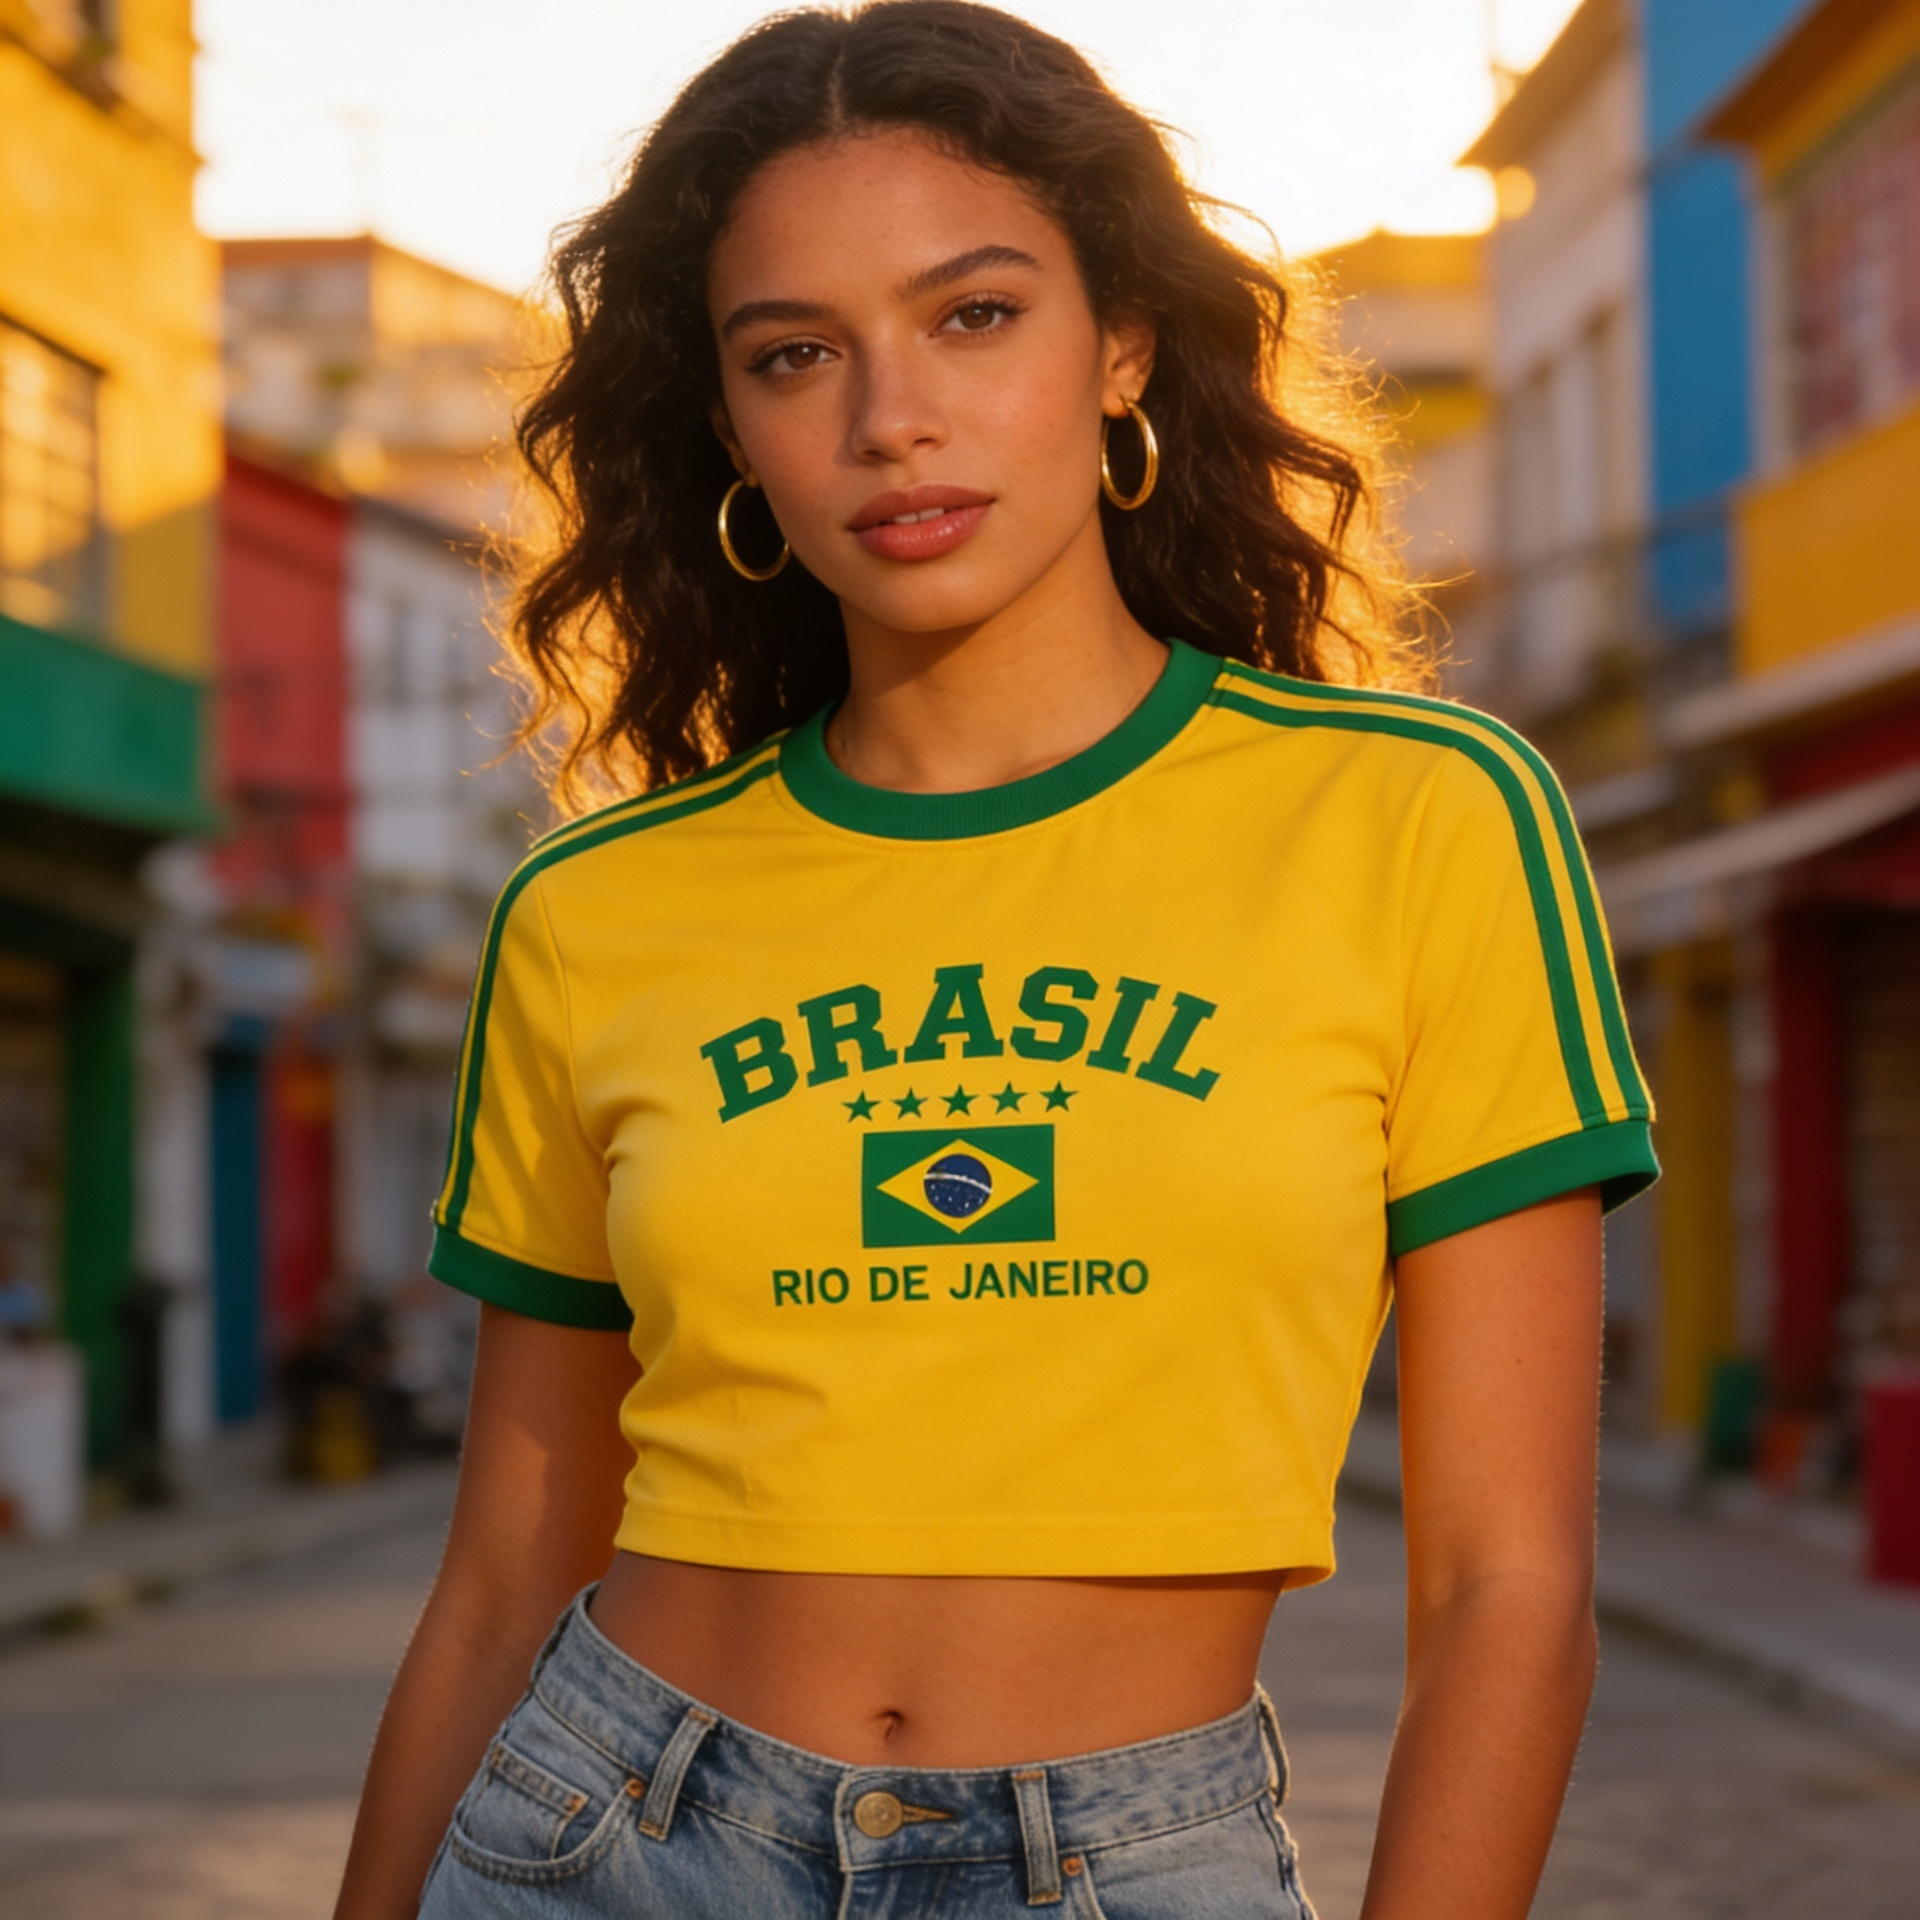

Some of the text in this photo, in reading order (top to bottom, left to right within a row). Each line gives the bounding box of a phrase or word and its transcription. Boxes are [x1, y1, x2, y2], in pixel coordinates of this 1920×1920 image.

[700, 963, 1221, 1123] BRASIL
[773, 1259, 1149, 1306] RIO DE JANEIRO
